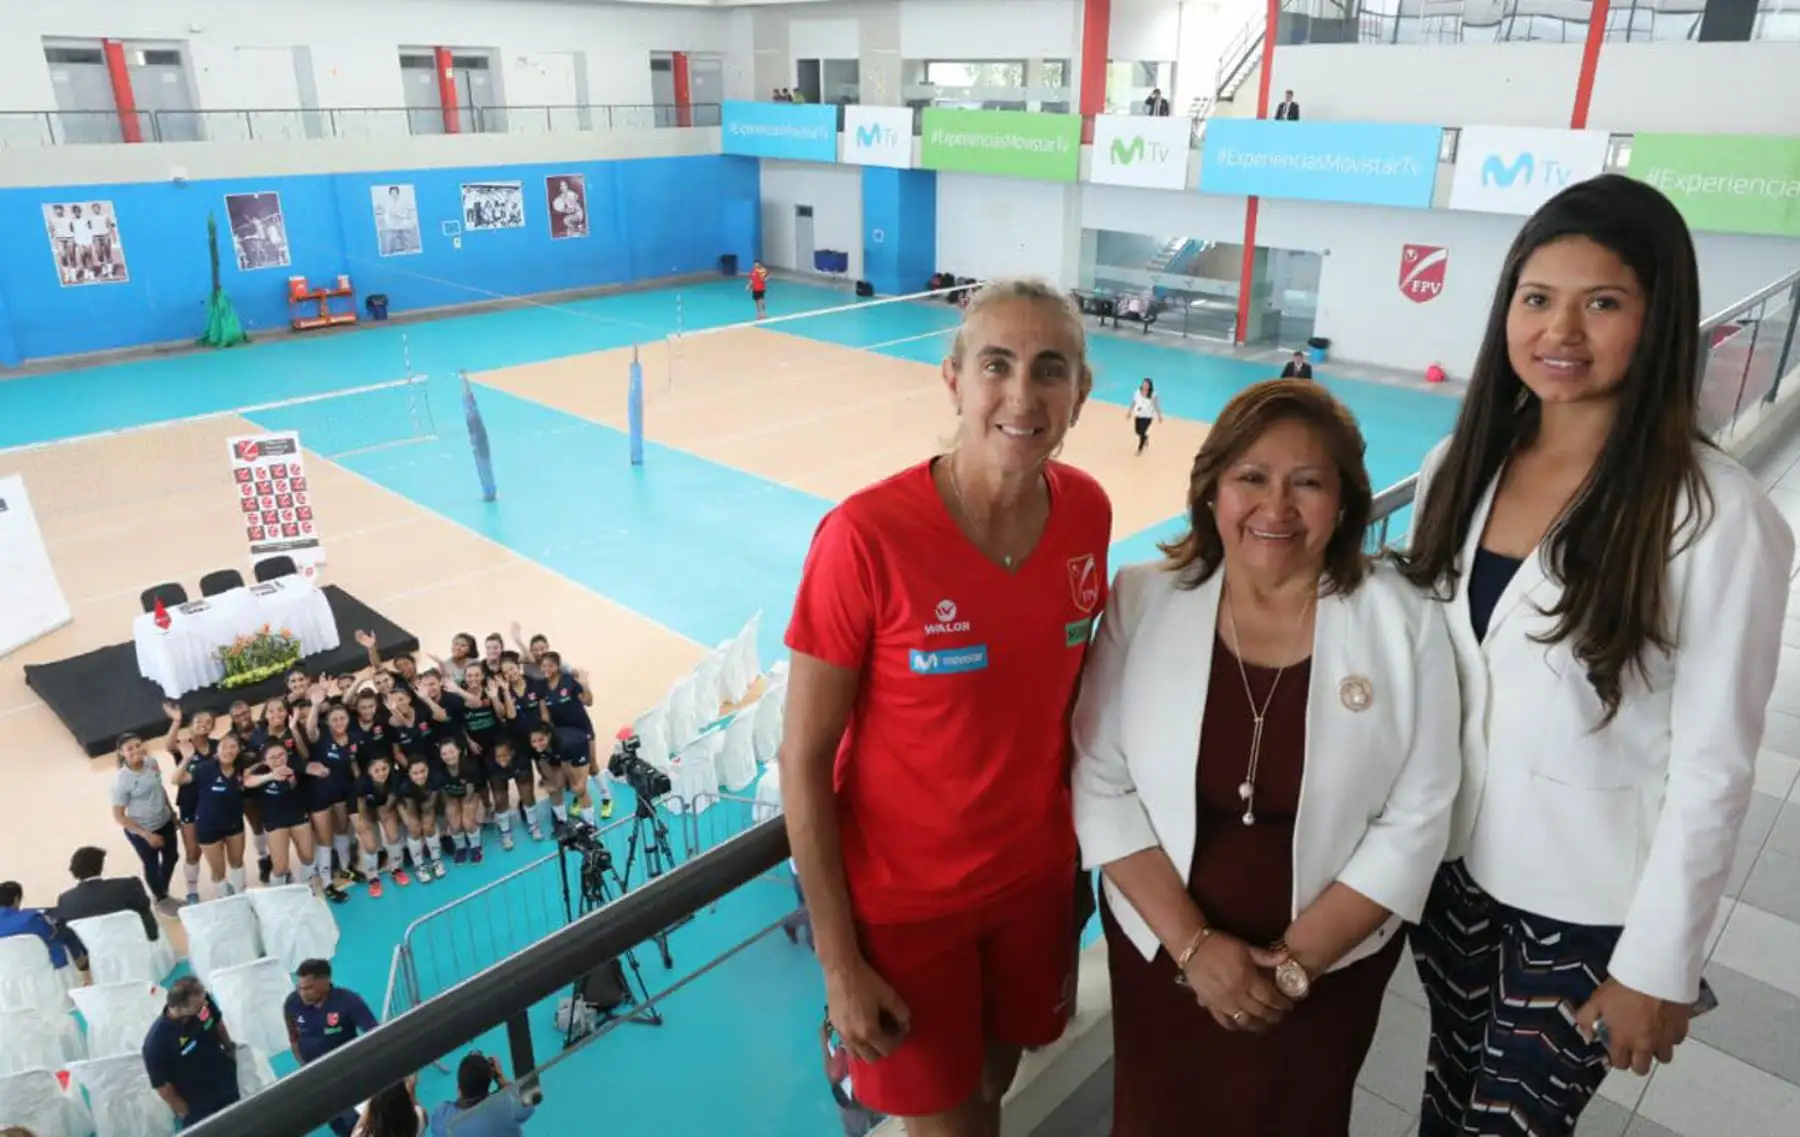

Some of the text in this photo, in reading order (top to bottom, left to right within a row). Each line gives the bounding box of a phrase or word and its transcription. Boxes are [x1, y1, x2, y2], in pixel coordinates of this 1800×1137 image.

[1148, 140, 1170, 163] Tv
[1543, 160, 1572, 186] Tv
[1411, 279, 1441, 296] FPV
